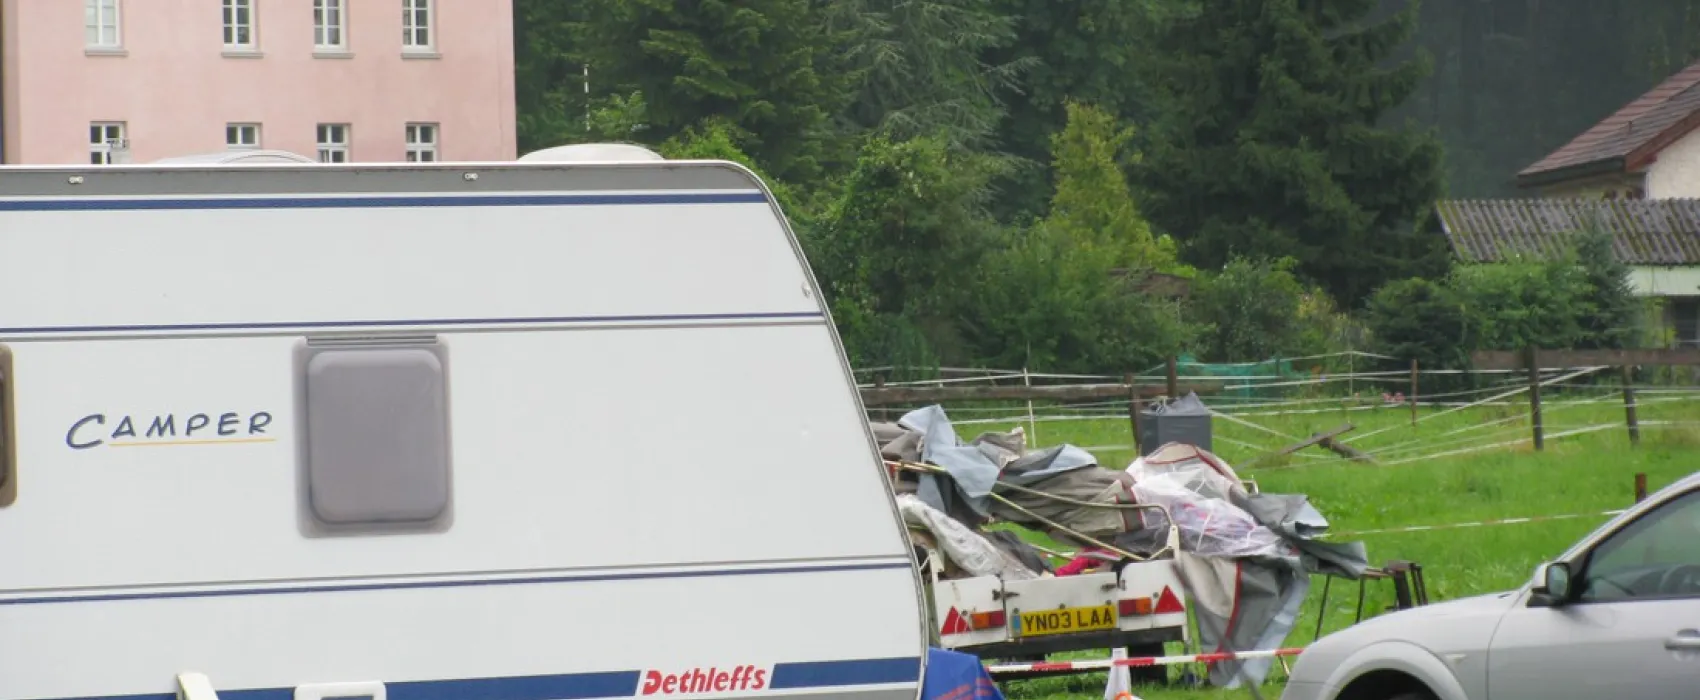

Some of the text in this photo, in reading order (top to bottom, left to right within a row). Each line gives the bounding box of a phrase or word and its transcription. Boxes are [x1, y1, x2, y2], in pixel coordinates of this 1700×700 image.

[66, 412, 273, 450] CAMPER
[1023, 607, 1114, 632] YN03 LAA
[642, 664, 766, 696] Dethleffs
